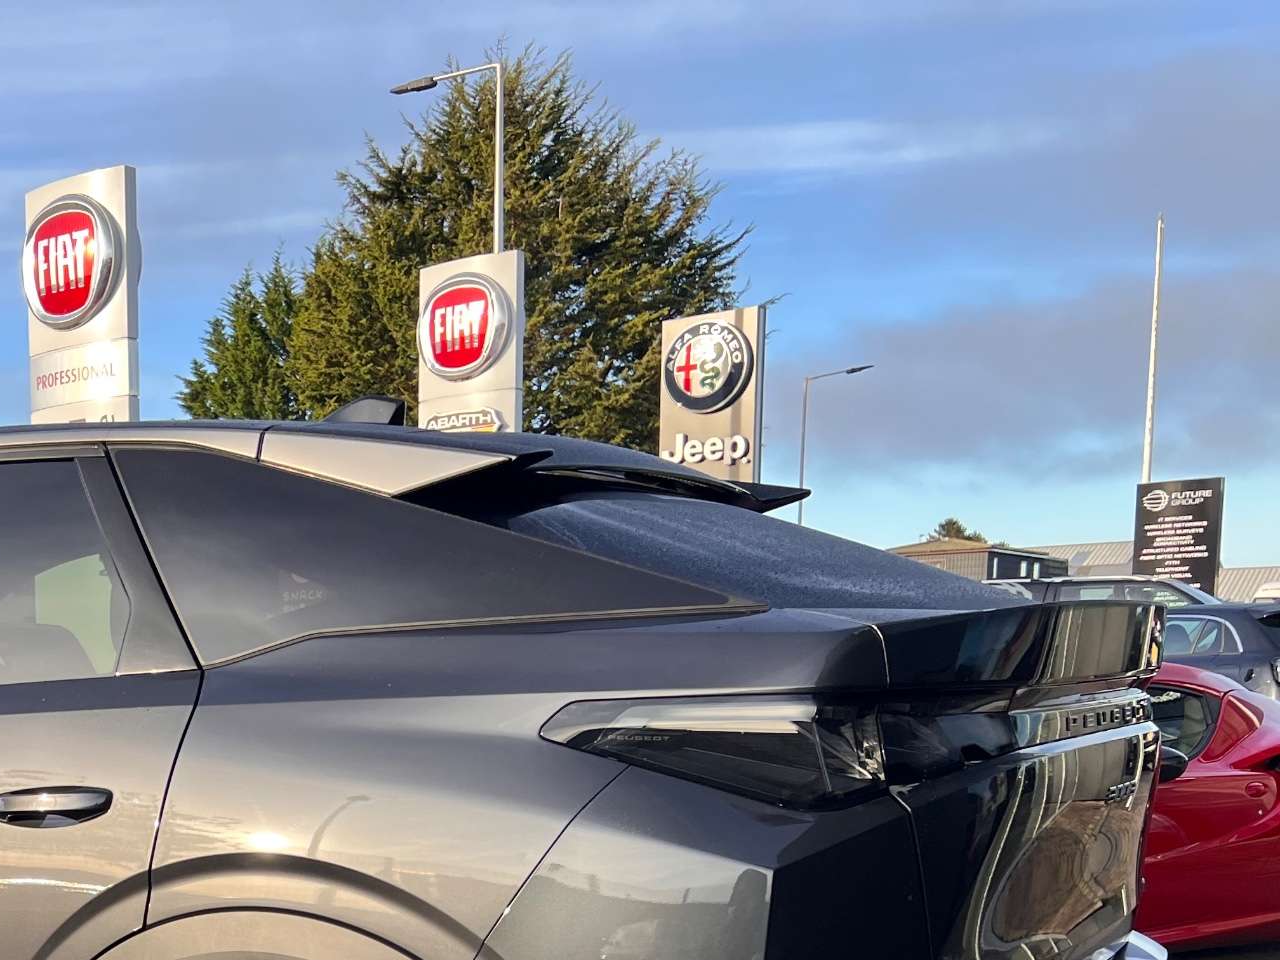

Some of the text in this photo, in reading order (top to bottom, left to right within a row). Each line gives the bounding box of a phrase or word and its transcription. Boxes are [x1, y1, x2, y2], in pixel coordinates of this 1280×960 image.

[37, 228, 89, 296] FIAT
[434, 300, 484, 353] FIAT
[666, 324, 742, 372] ALFA ROMEO
[36, 363, 116, 391] PROFESSIONAL
[428, 412, 491, 430] ABARTH
[662, 433, 750, 465] Jeep
[1171, 490, 1213, 498] FUTURE
[1171, 498, 1204, 506] GROUP
